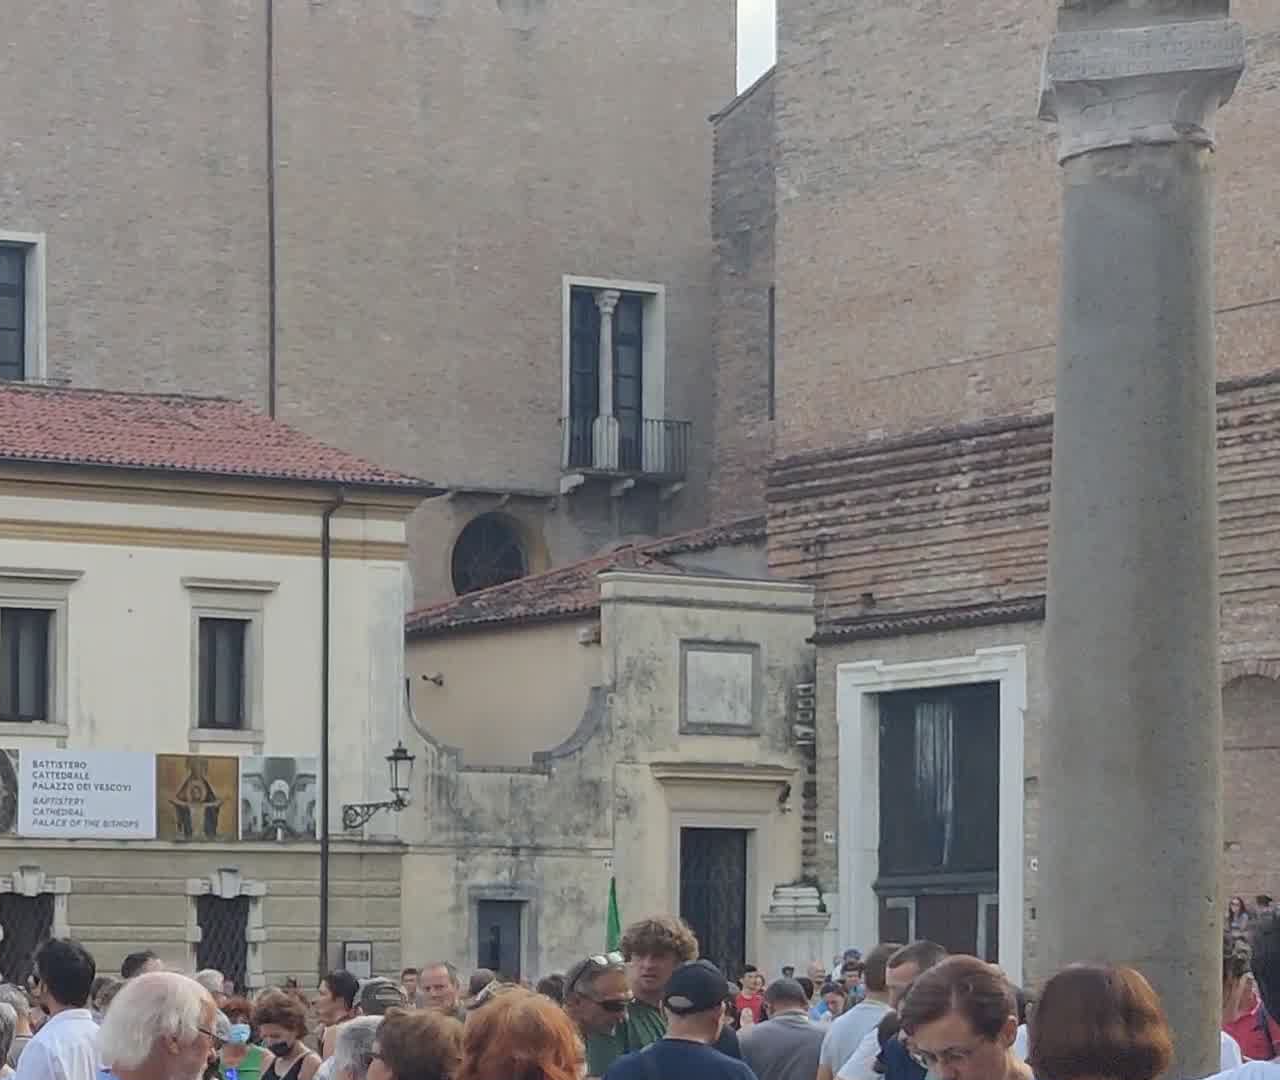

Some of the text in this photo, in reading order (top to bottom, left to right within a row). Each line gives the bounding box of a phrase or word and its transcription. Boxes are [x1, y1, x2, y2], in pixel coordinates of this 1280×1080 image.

[32, 760, 88, 770] BATTISTERO
[32, 771, 90, 781] CATTEDRALE
[32, 782, 132, 792] PALAZZO DEI VESCOVI
